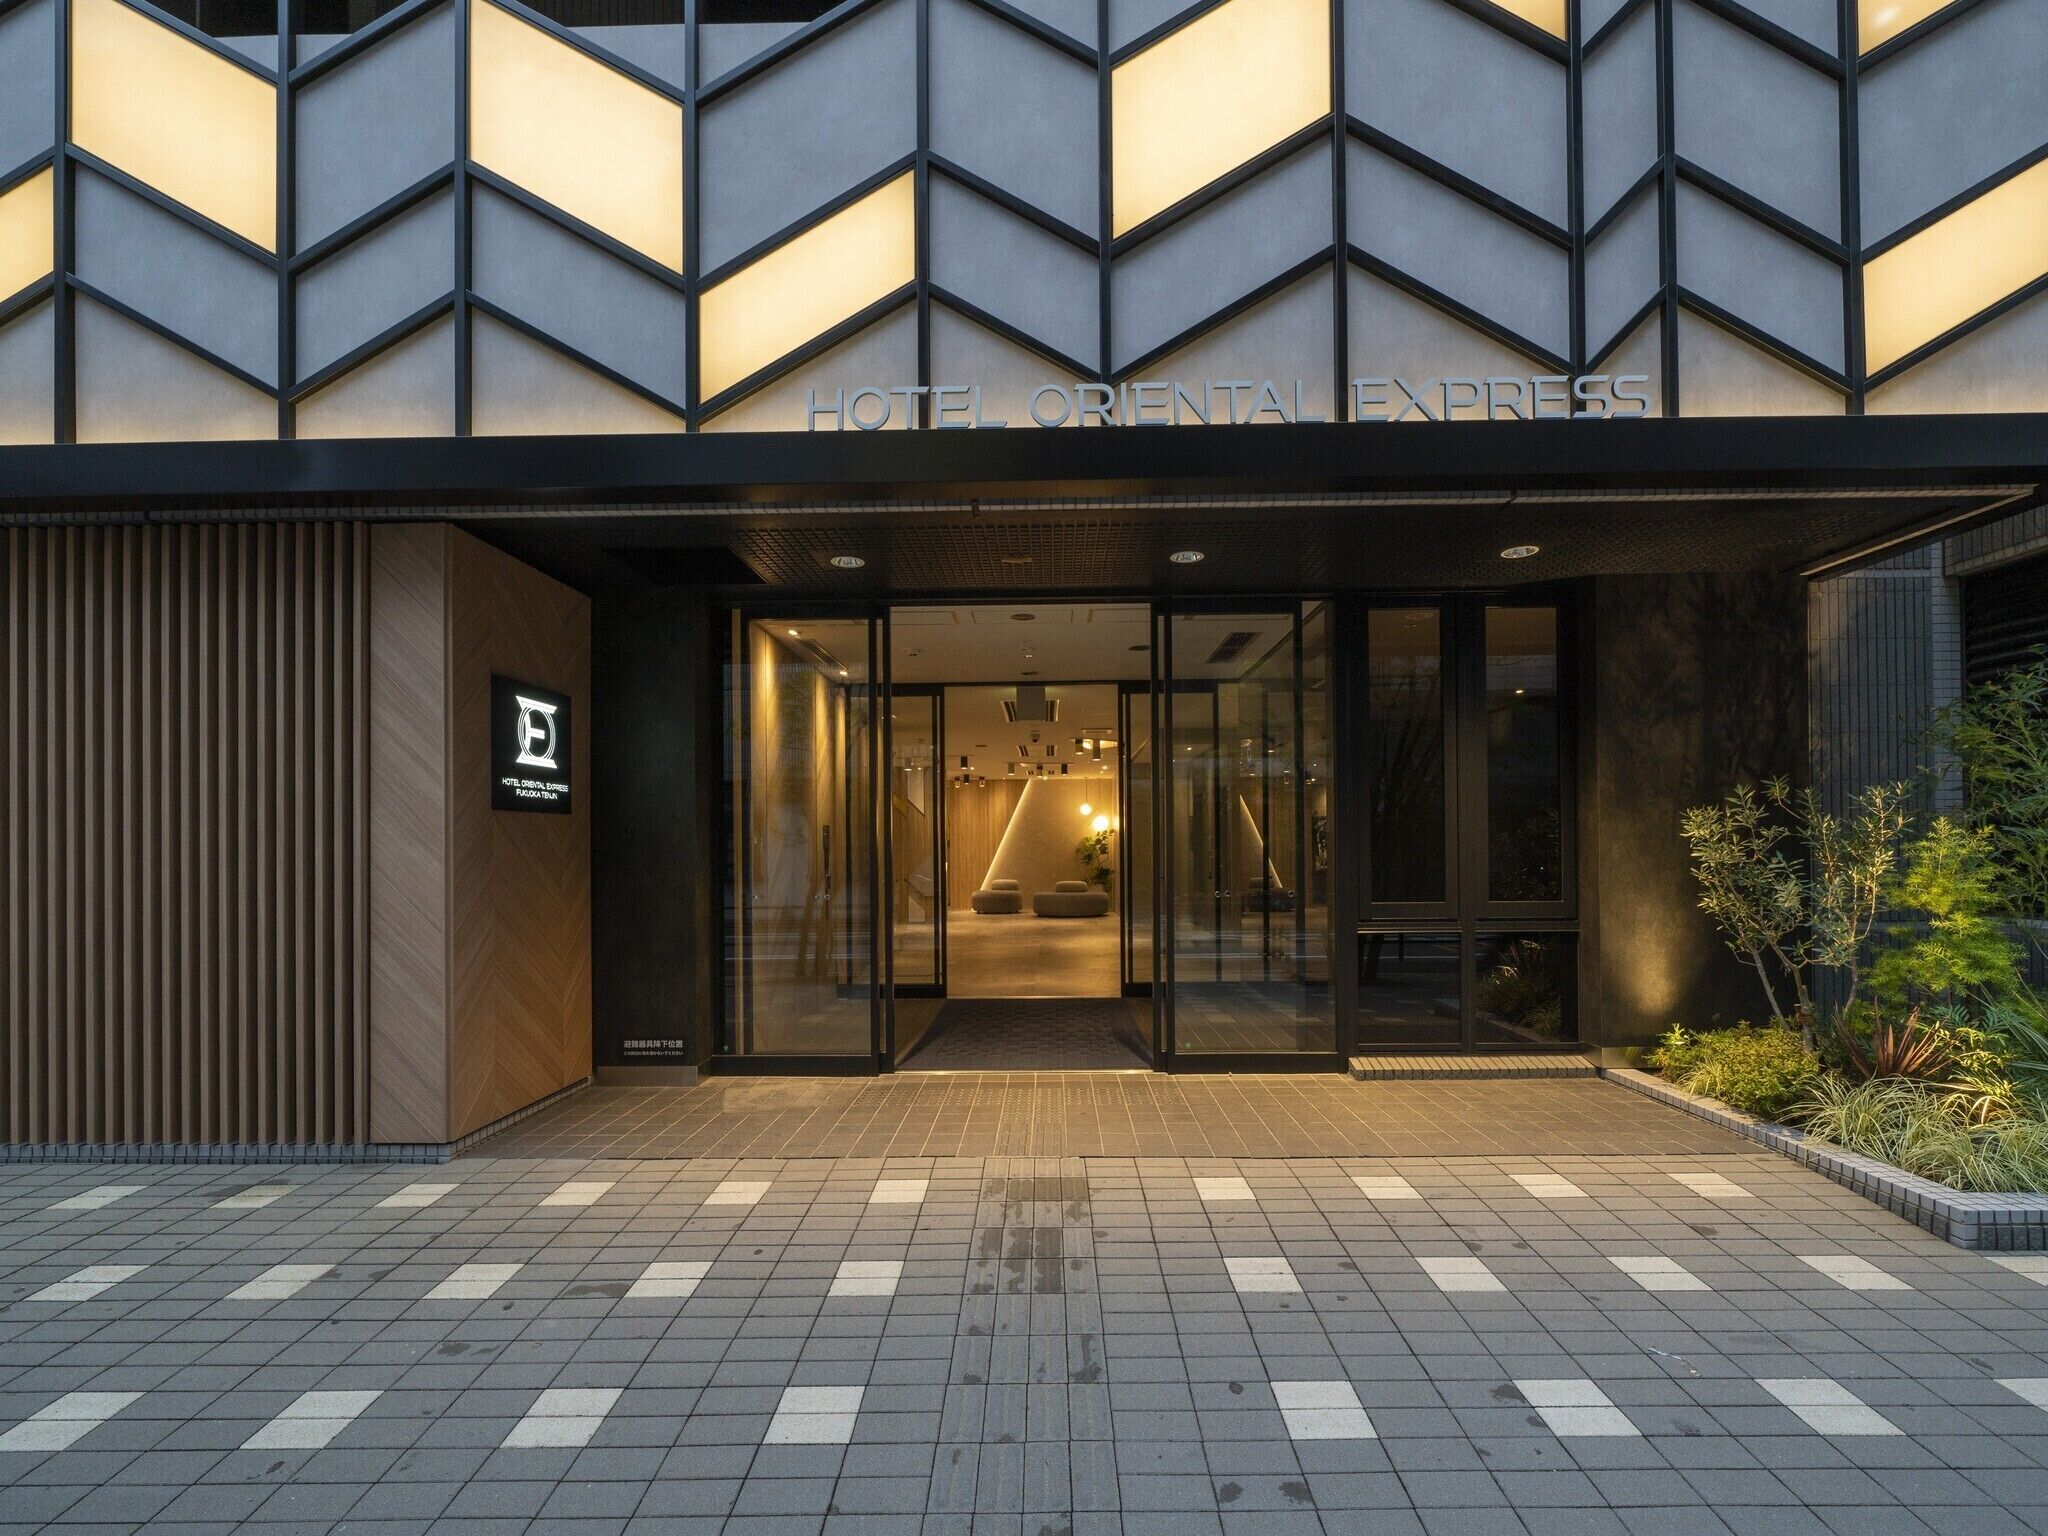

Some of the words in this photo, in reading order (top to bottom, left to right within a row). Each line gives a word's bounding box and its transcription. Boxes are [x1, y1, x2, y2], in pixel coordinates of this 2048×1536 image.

[807, 384, 1008, 431] HOTEL
[1030, 379, 1327, 427] ORIENTAL
[1352, 375, 1651, 423] EXPRESS
[502, 777, 521, 787] HOTEL
[521, 779, 546, 790] ORIENTAL
[546, 783, 569, 792] EXPRESS
[516, 788, 541, 798] FUKUOKA
